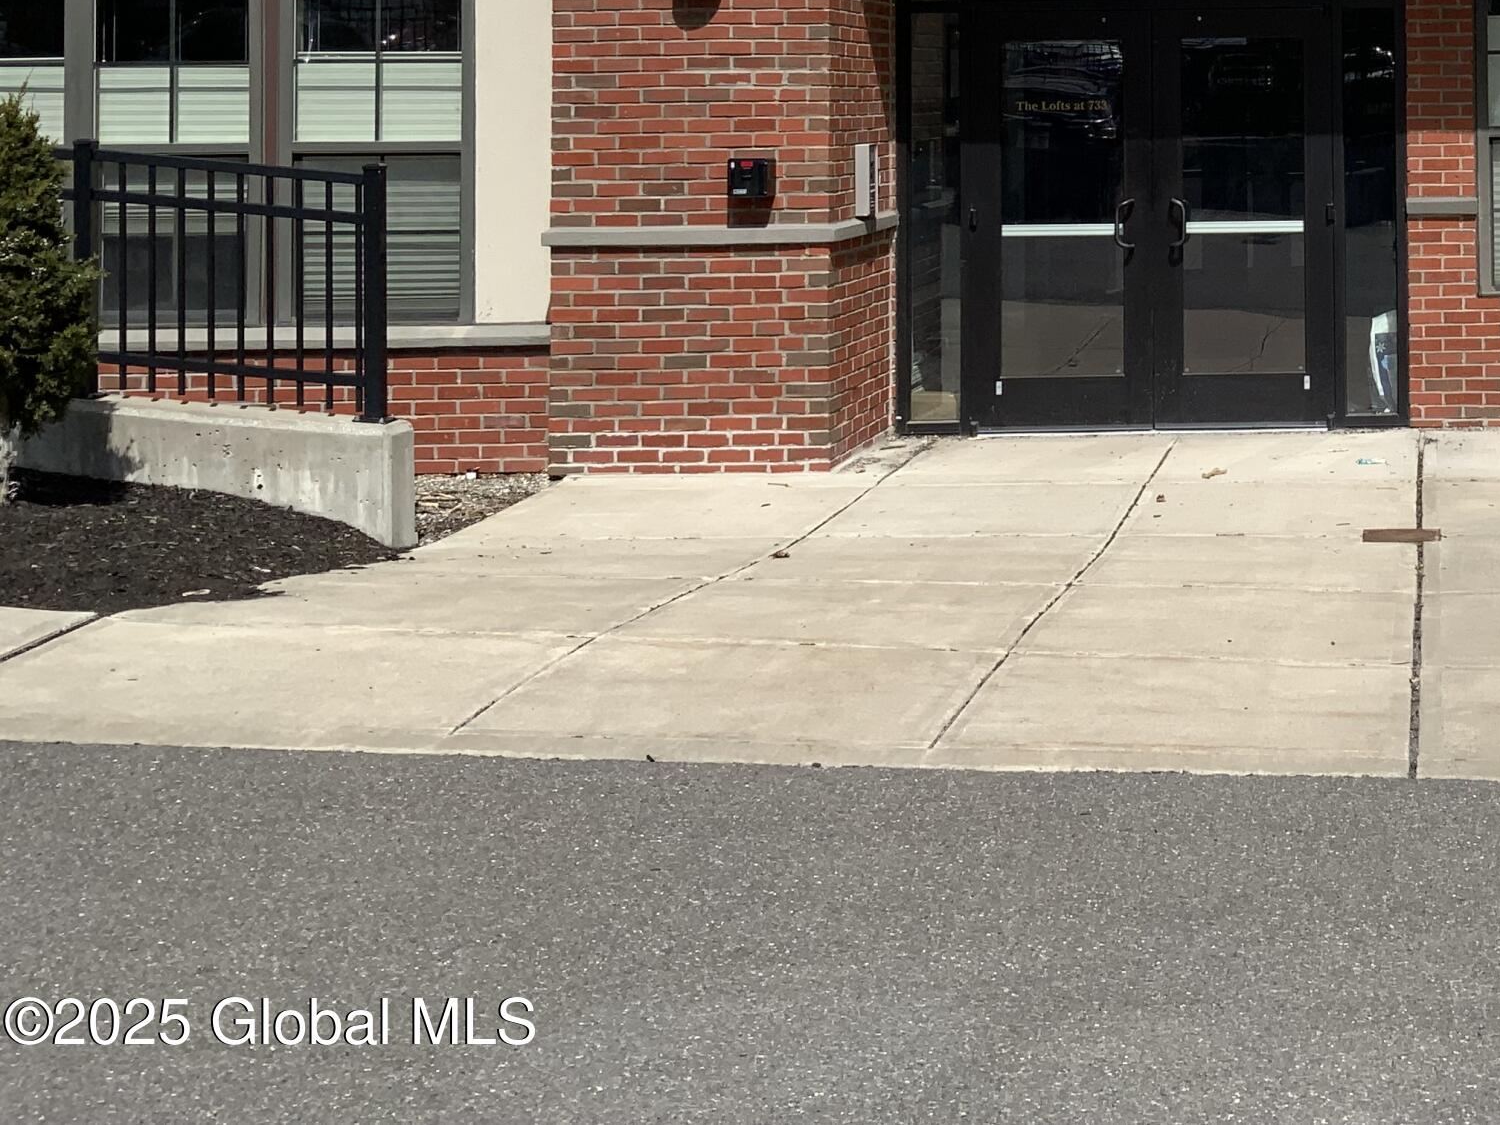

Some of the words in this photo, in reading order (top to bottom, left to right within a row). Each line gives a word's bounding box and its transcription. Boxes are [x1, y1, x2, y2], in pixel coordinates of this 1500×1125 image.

[1016, 100, 1038, 111] The
[1042, 100, 1071, 111] Lofts
[1074, 101, 1085, 111] at
[1088, 99, 1108, 111] 733
